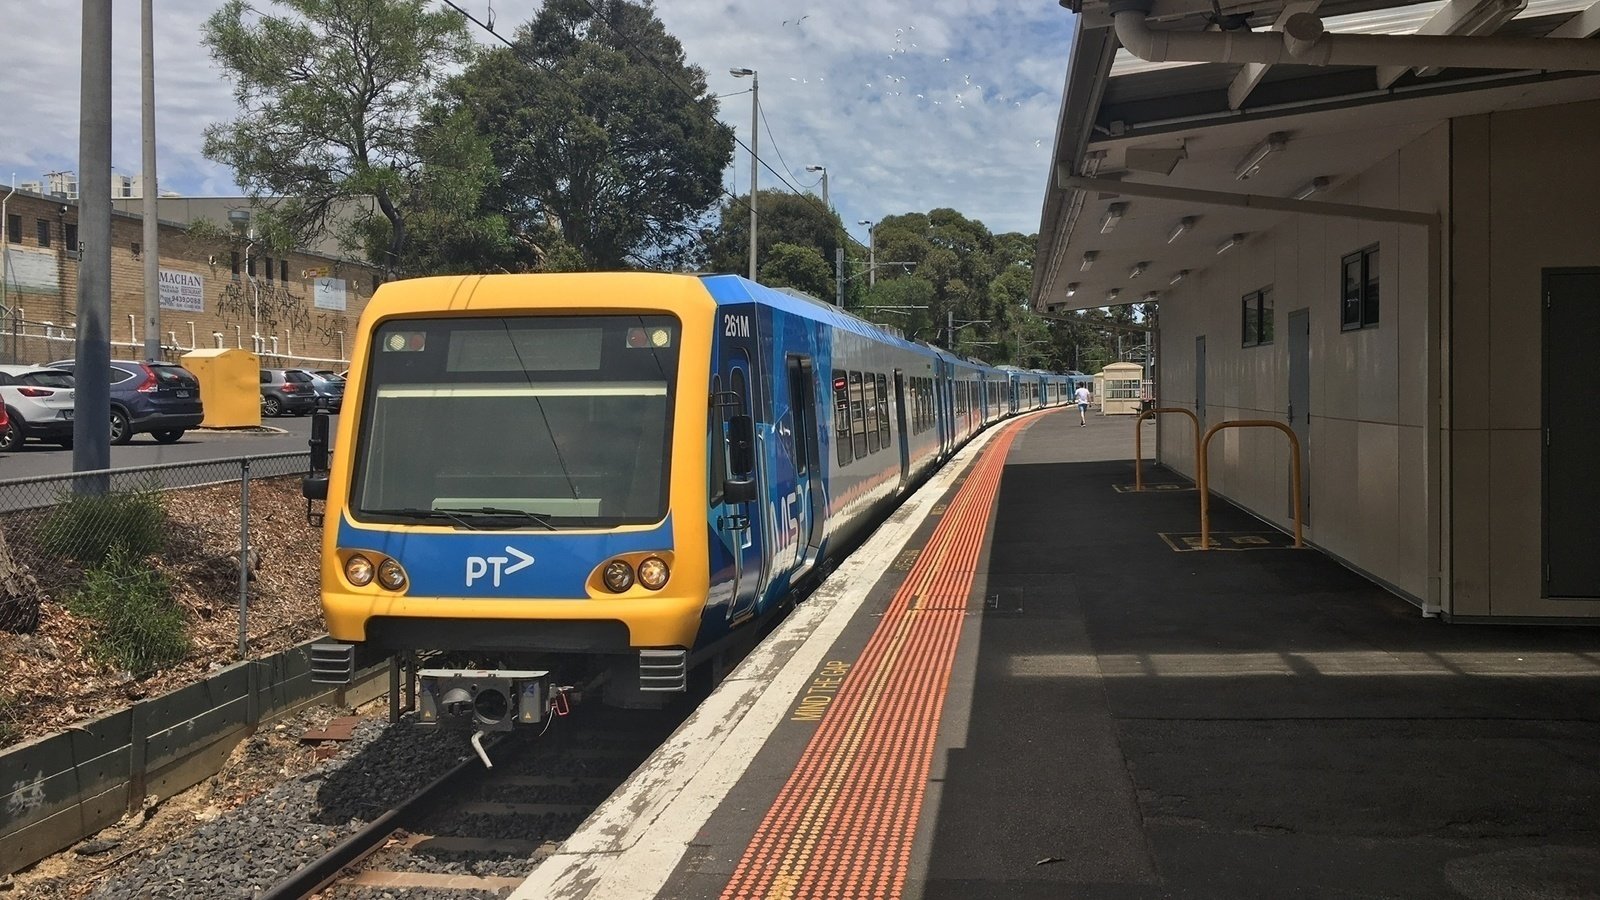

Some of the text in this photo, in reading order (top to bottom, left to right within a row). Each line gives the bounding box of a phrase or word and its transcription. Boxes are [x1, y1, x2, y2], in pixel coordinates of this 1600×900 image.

[159, 271, 201, 287] MACHAN
[725, 314, 750, 338] 261M
[790, 660, 852, 721] MIND THE GAP
